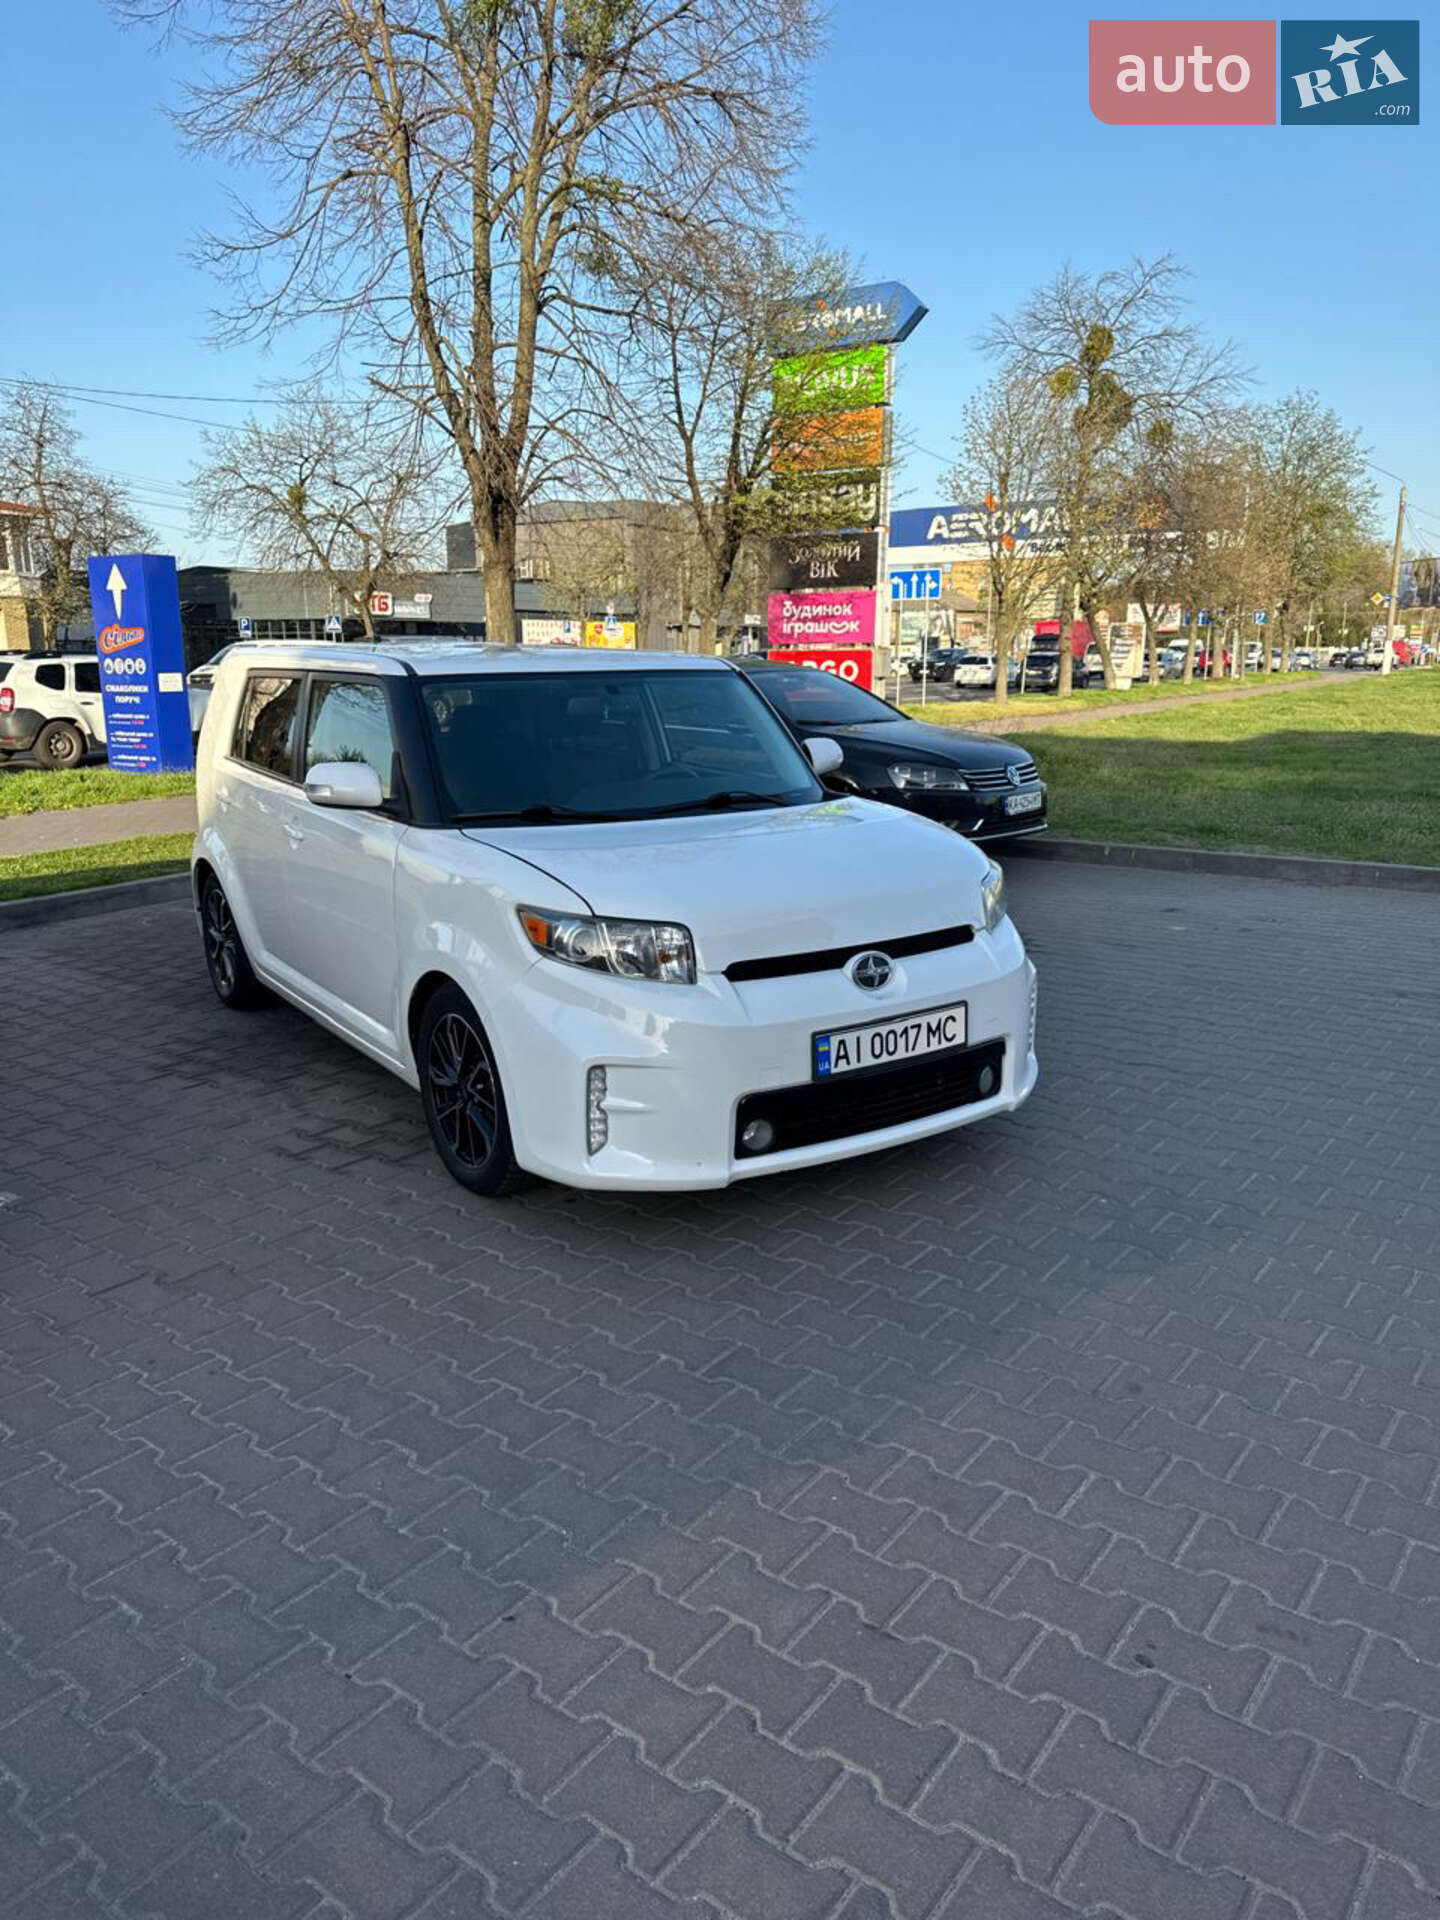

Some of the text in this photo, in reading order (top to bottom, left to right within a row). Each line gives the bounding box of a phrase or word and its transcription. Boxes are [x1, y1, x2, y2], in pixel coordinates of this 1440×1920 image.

[926, 506, 1072, 541] AEROMA
[782, 601, 852, 619] будинок
[782, 620, 860, 639] іграшок
[834, 1015, 957, 1069] AI 0017 MC
[817, 1061, 830, 1072] UA
